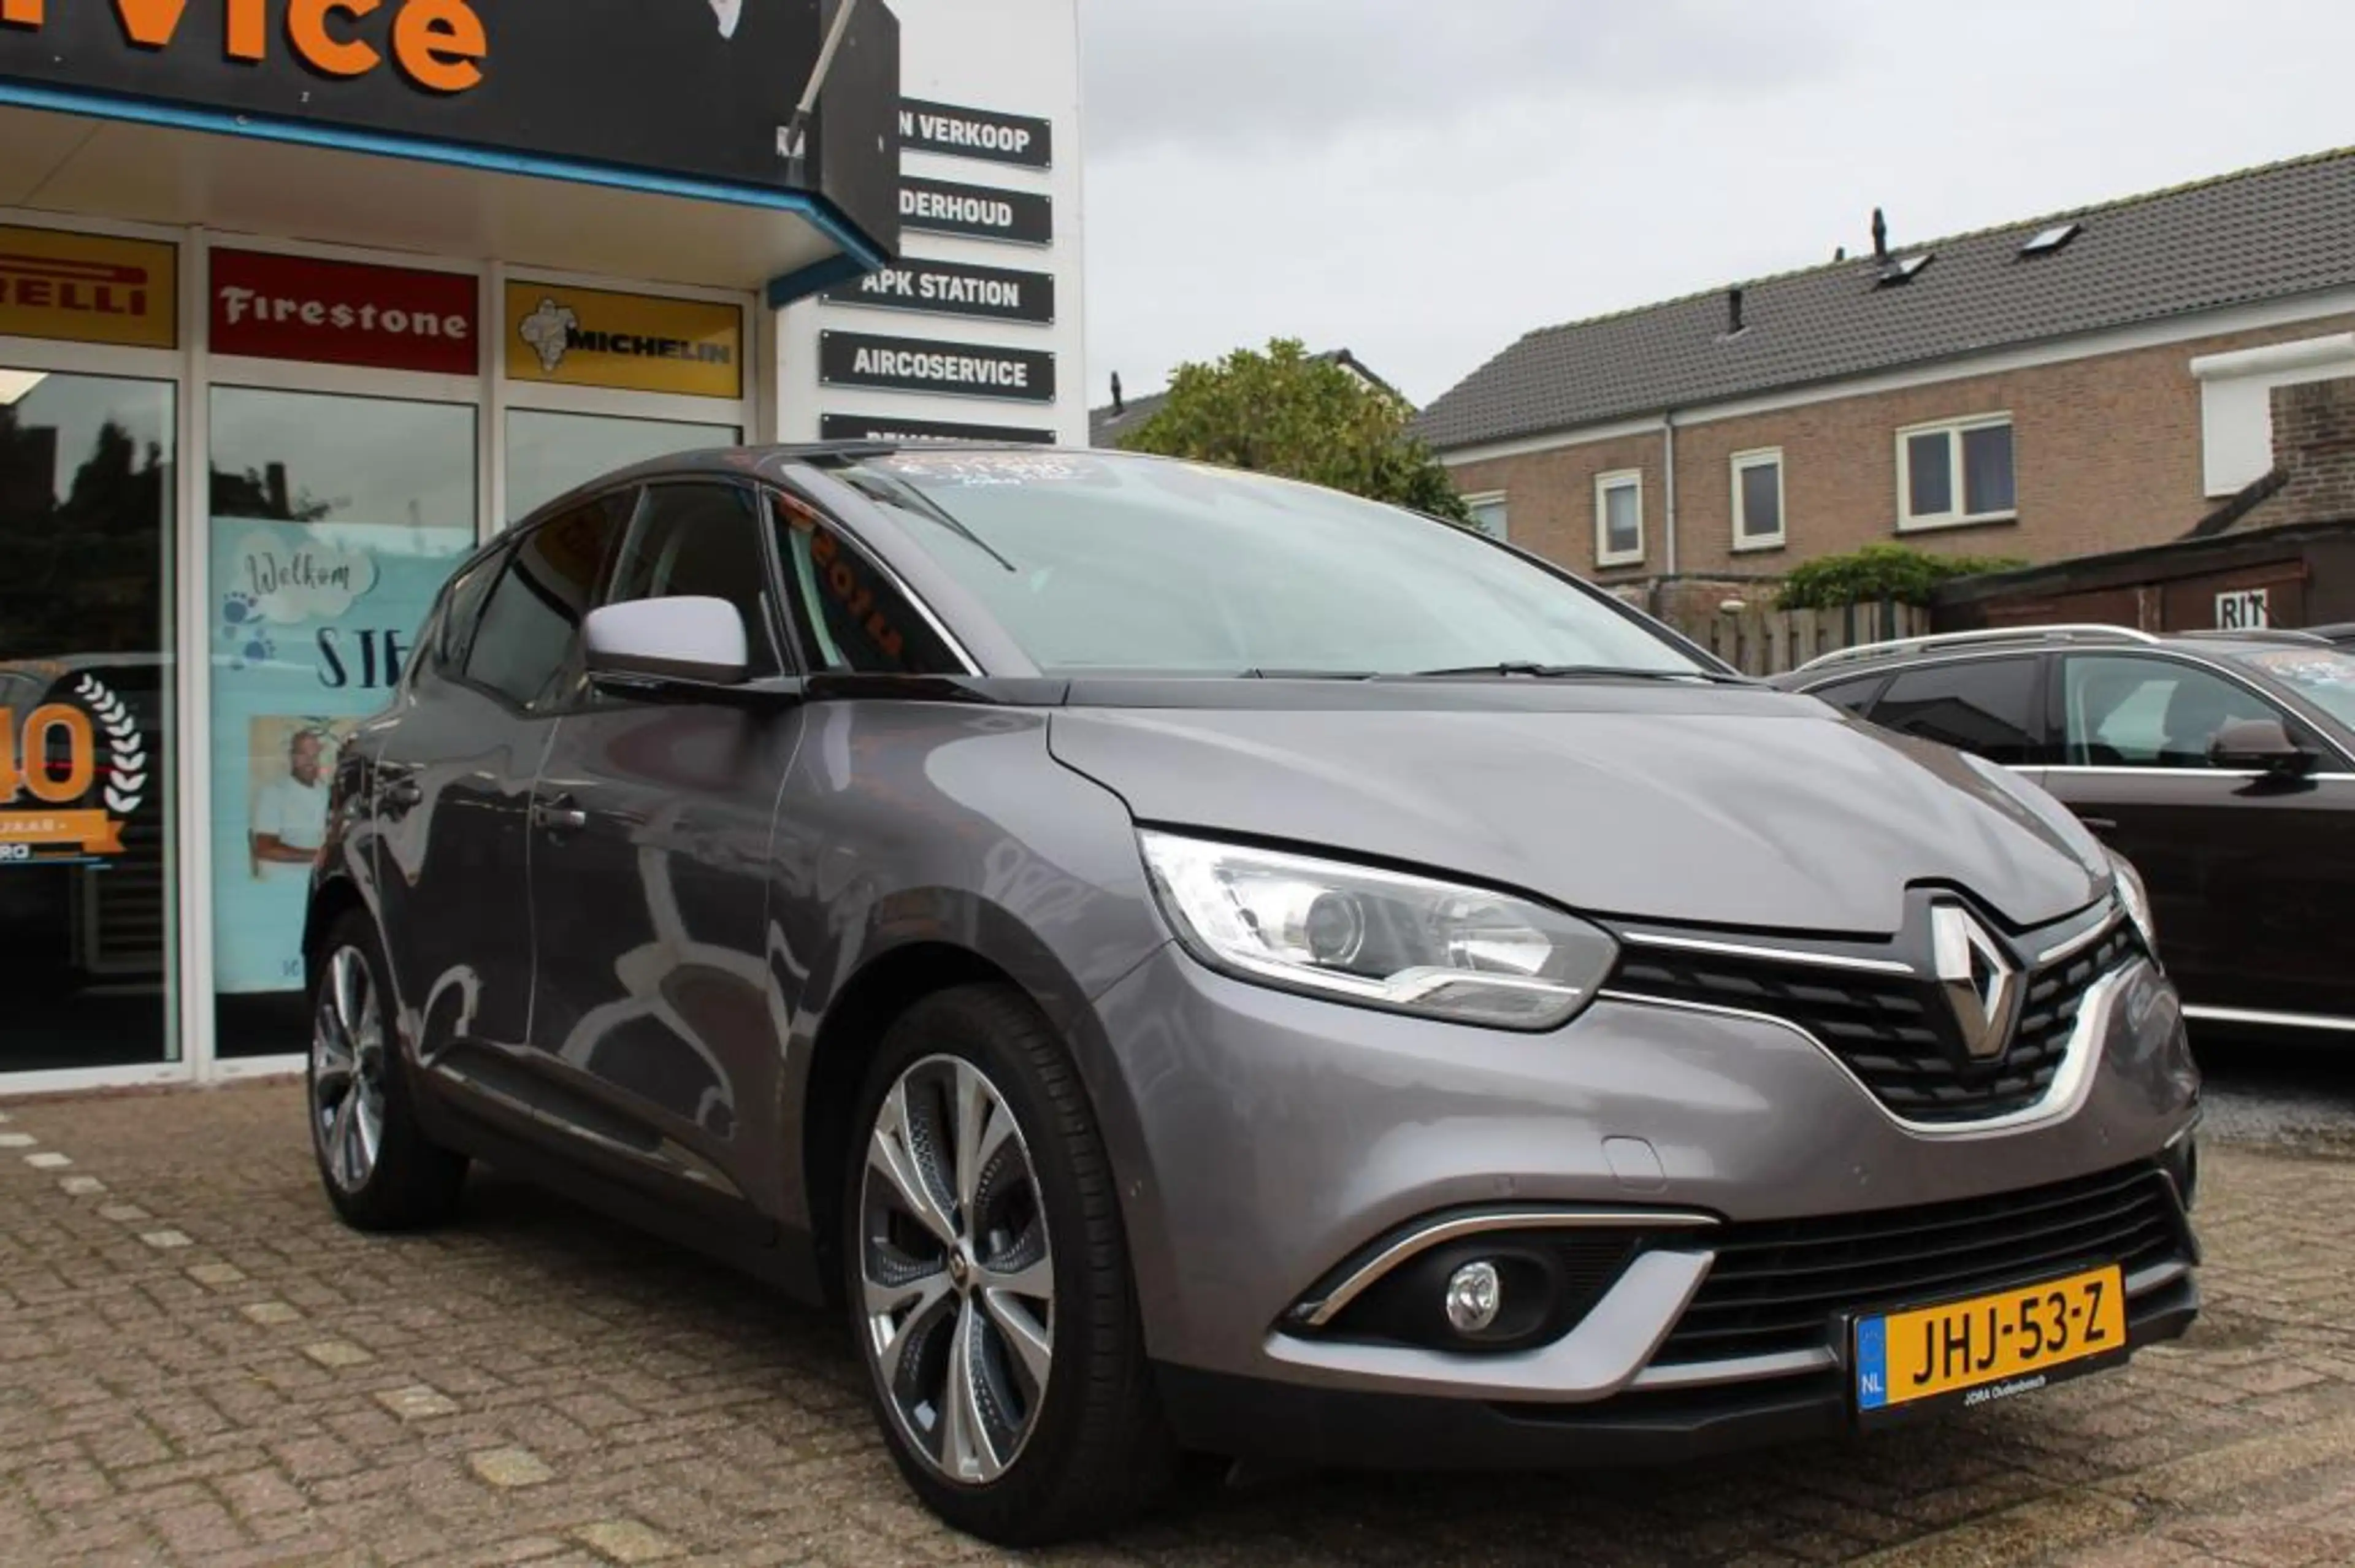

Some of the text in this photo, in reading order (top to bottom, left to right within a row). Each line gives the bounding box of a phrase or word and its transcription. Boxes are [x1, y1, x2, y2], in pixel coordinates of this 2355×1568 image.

[0, 0, 487, 91] vice
[919, 114, 1030, 153] VERKOOP
[899, 189, 1013, 227] DERHOUD
[0, 277, 147, 316] ELLI
[862, 269, 1019, 307] APK STATION
[220, 286, 468, 338] Firestone
[566, 326, 730, 364] MICHELIN
[853, 347, 1027, 387] AIRCOSERVICE
[248, 552, 350, 595] Welkom
[2221, 595, 2264, 629] RIT
[1913, 1280, 2105, 1385] JHJ-53-Z
[1861, 1375, 1884, 1394] NL
